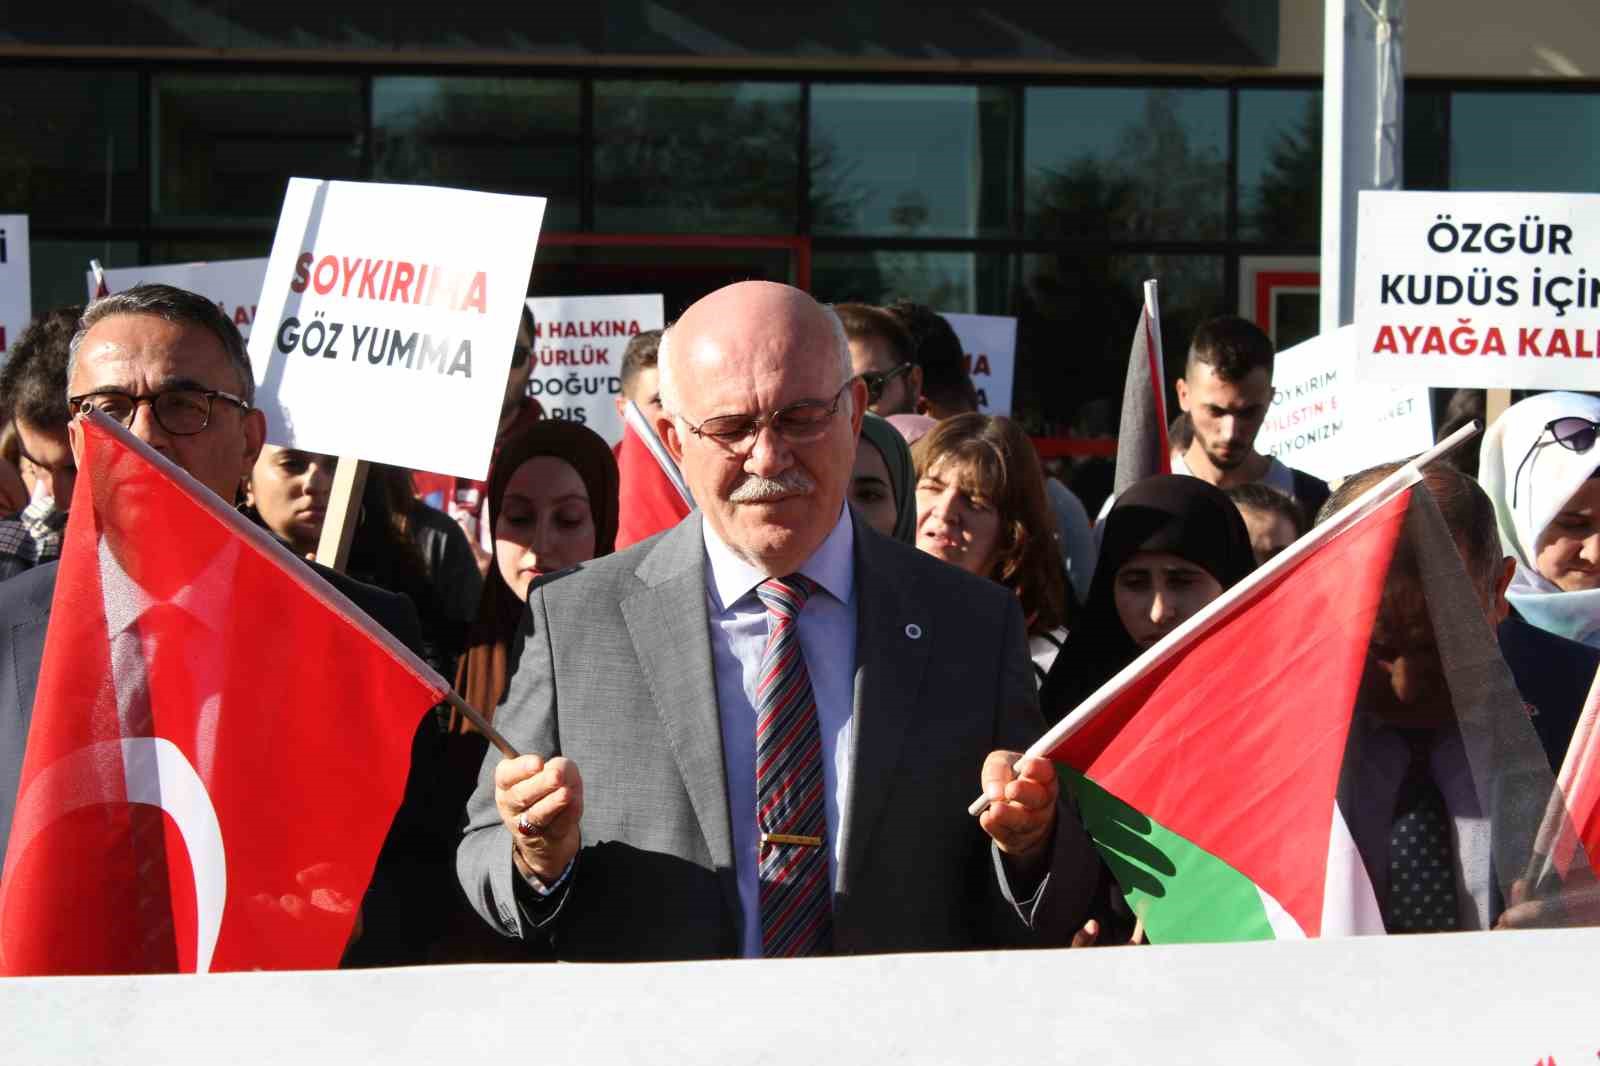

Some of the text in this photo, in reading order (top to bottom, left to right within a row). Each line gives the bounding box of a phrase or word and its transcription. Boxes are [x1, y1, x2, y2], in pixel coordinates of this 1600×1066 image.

[1427, 214, 1573, 255] ÖZGÜR
[1381, 267, 1519, 306] KUDÜS
[277, 311, 472, 378] GÖZ YUMMA
[548, 320, 640, 338] HALKINA
[1373, 318, 1600, 358] AYAĞA KAL
[529, 372, 622, 395] DOĞU'D
[1272, 370, 1337, 406] OYKIRIM
